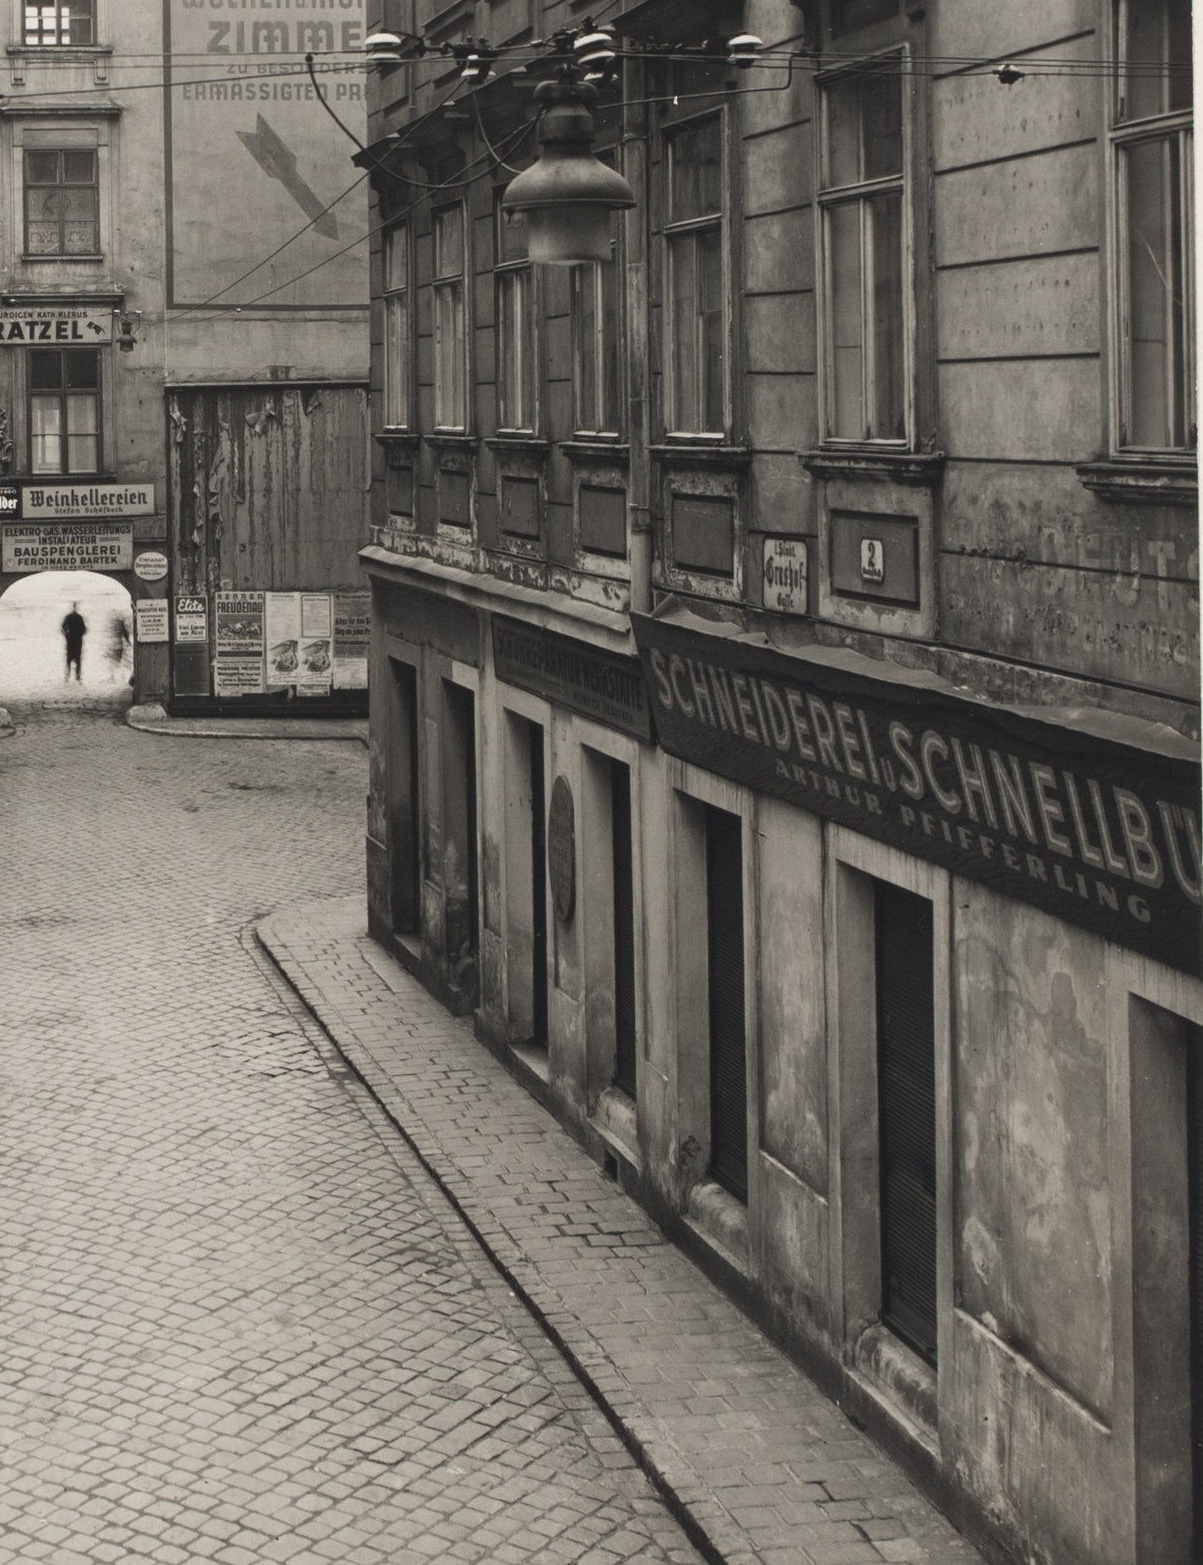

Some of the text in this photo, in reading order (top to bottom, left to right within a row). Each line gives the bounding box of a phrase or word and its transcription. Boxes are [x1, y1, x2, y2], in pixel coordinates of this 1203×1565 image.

[29, 488, 148, 508] Weinkellereien
[14, 545, 120, 557] BAUSPENGLEREI
[18, 556, 117, 566] FERDINAND BARTEK
[868, 541, 875, 567] 2
[177, 598, 205, 613] Elite
[650, 646, 880, 786] SCHNEIDEREI
[776, 758, 1151, 923] ARTHUR PFIFFERLING
